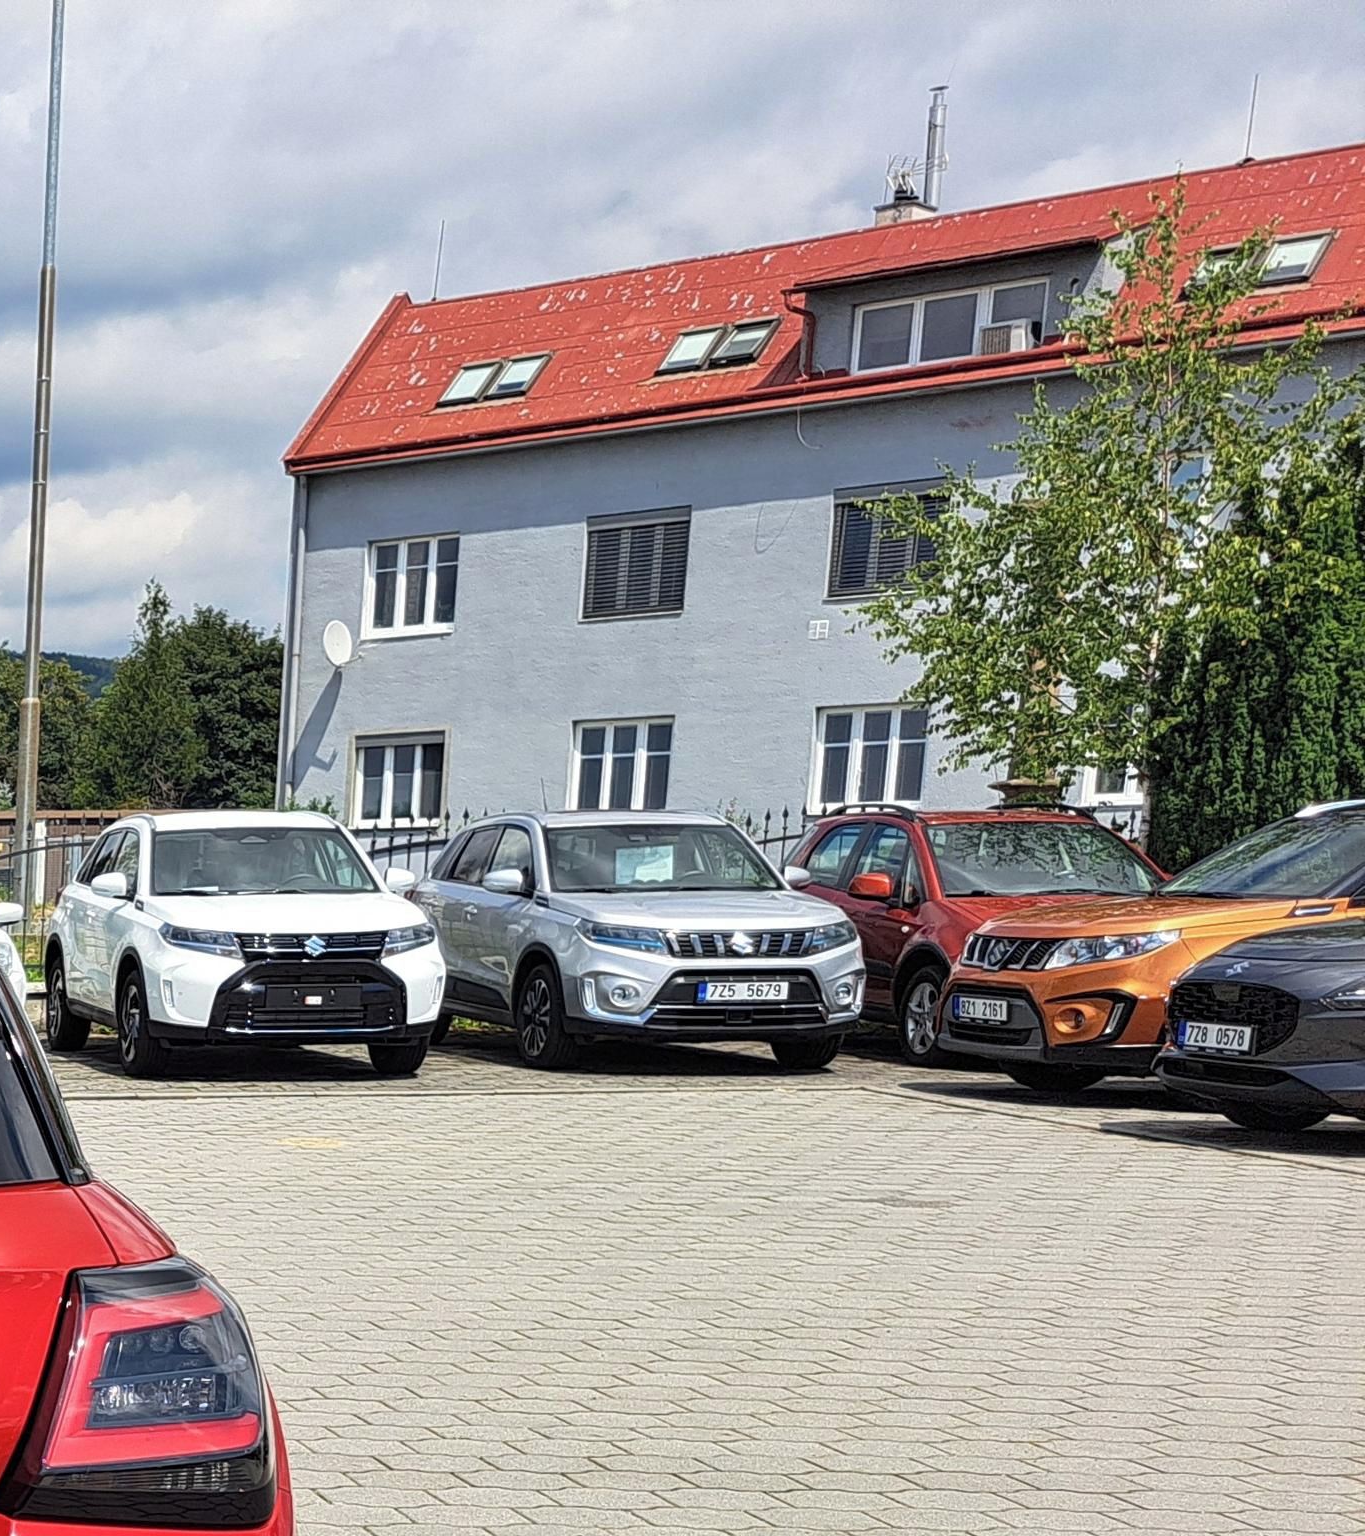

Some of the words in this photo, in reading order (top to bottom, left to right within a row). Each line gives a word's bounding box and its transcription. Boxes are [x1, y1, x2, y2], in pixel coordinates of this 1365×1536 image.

[710, 985, 736, 998] 7Z5
[747, 984, 782, 998] 5679
[961, 1000, 976, 1016] 8Z1
[982, 1002, 1003, 1018] 2161
[1187, 1024, 1209, 1043] 7Z8
[1215, 1027, 1245, 1047] 0578
